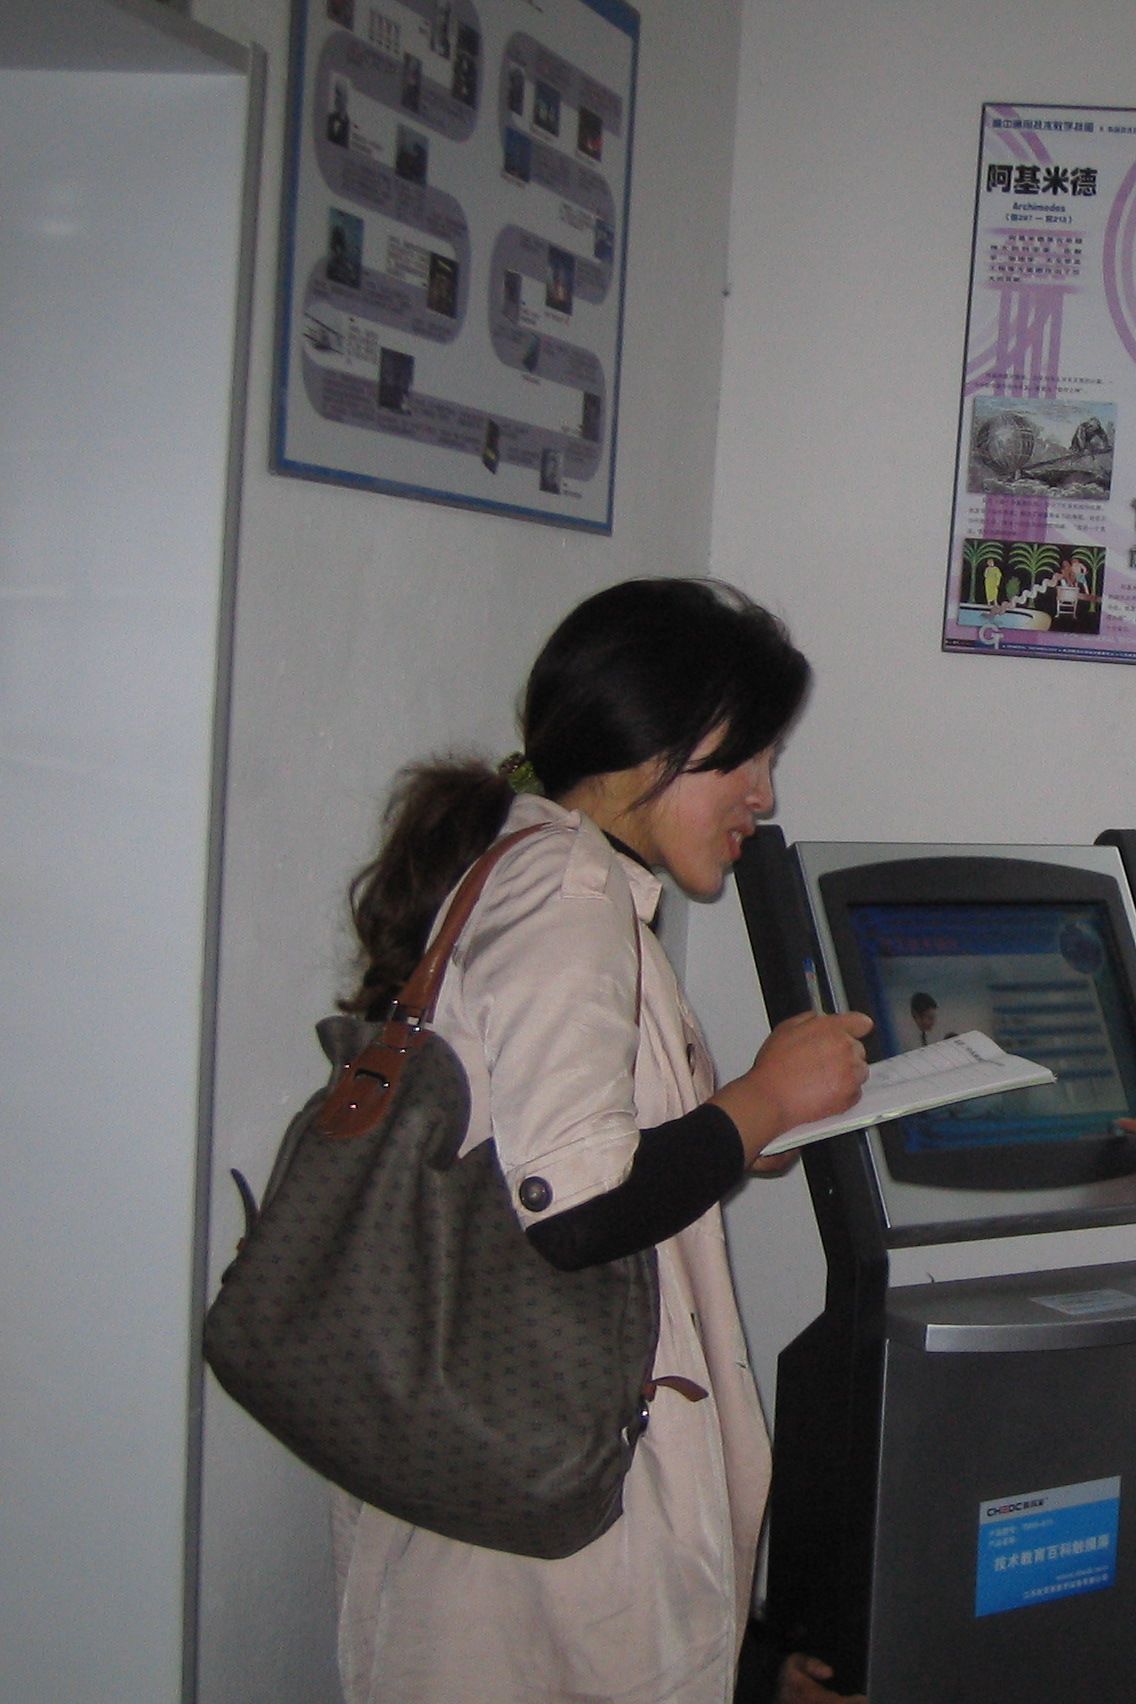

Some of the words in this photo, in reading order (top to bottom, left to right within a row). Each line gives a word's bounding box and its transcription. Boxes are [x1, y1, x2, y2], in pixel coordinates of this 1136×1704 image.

[986, 164, 1098, 196] 阿基米德
[1012, 202, 1066, 213] Archimedes
